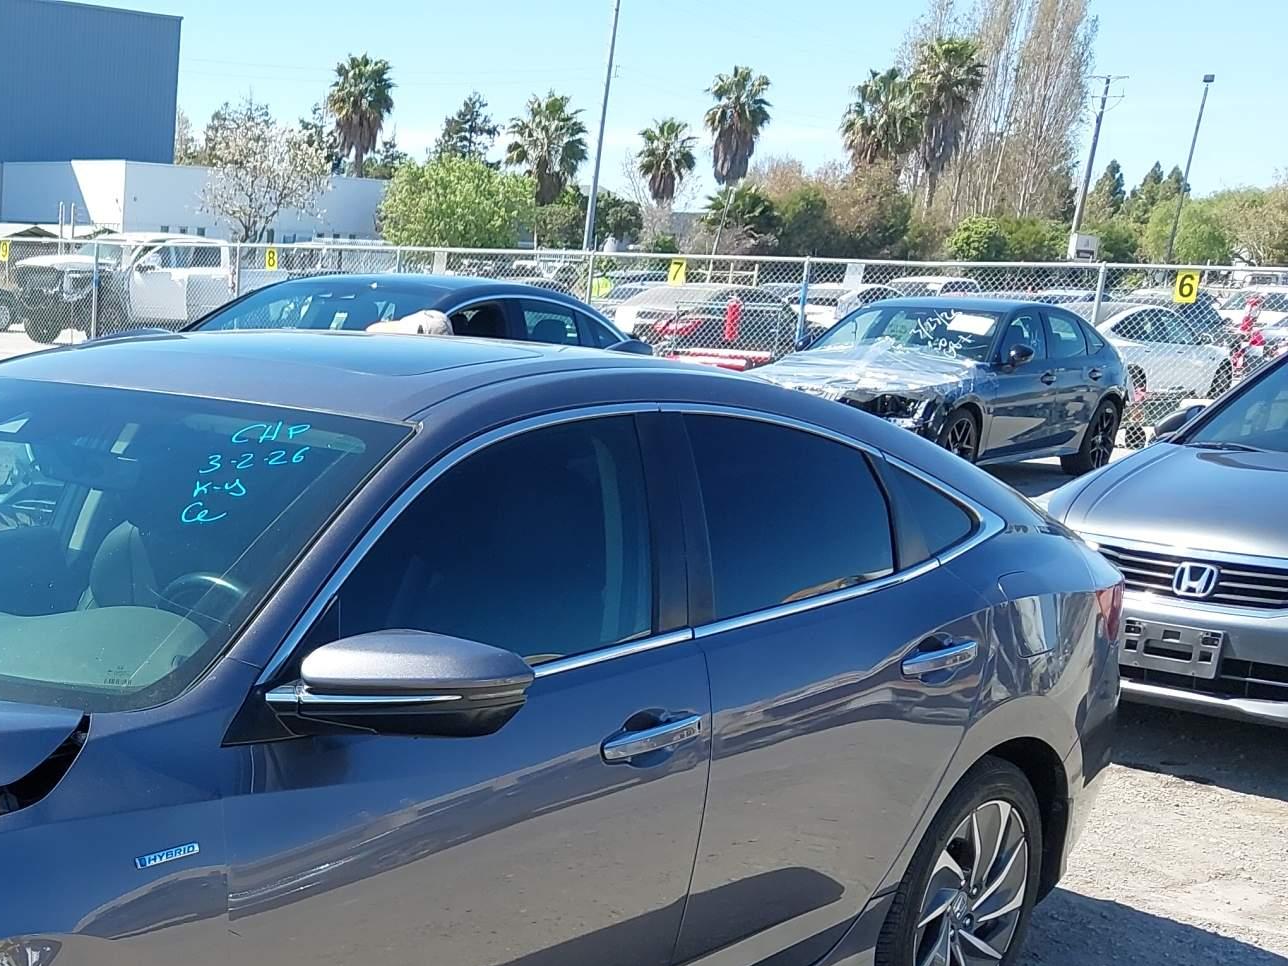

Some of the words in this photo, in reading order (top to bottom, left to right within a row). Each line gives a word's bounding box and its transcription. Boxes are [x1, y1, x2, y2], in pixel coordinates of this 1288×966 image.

[2, 242, 7, 257] 9
[268, 250, 275, 267] 8
[673, 261, 684, 281] 7
[1179, 274, 1195, 298] 6
[231, 421, 311, 443] CHP
[148, 844, 195, 864] HYBRID
